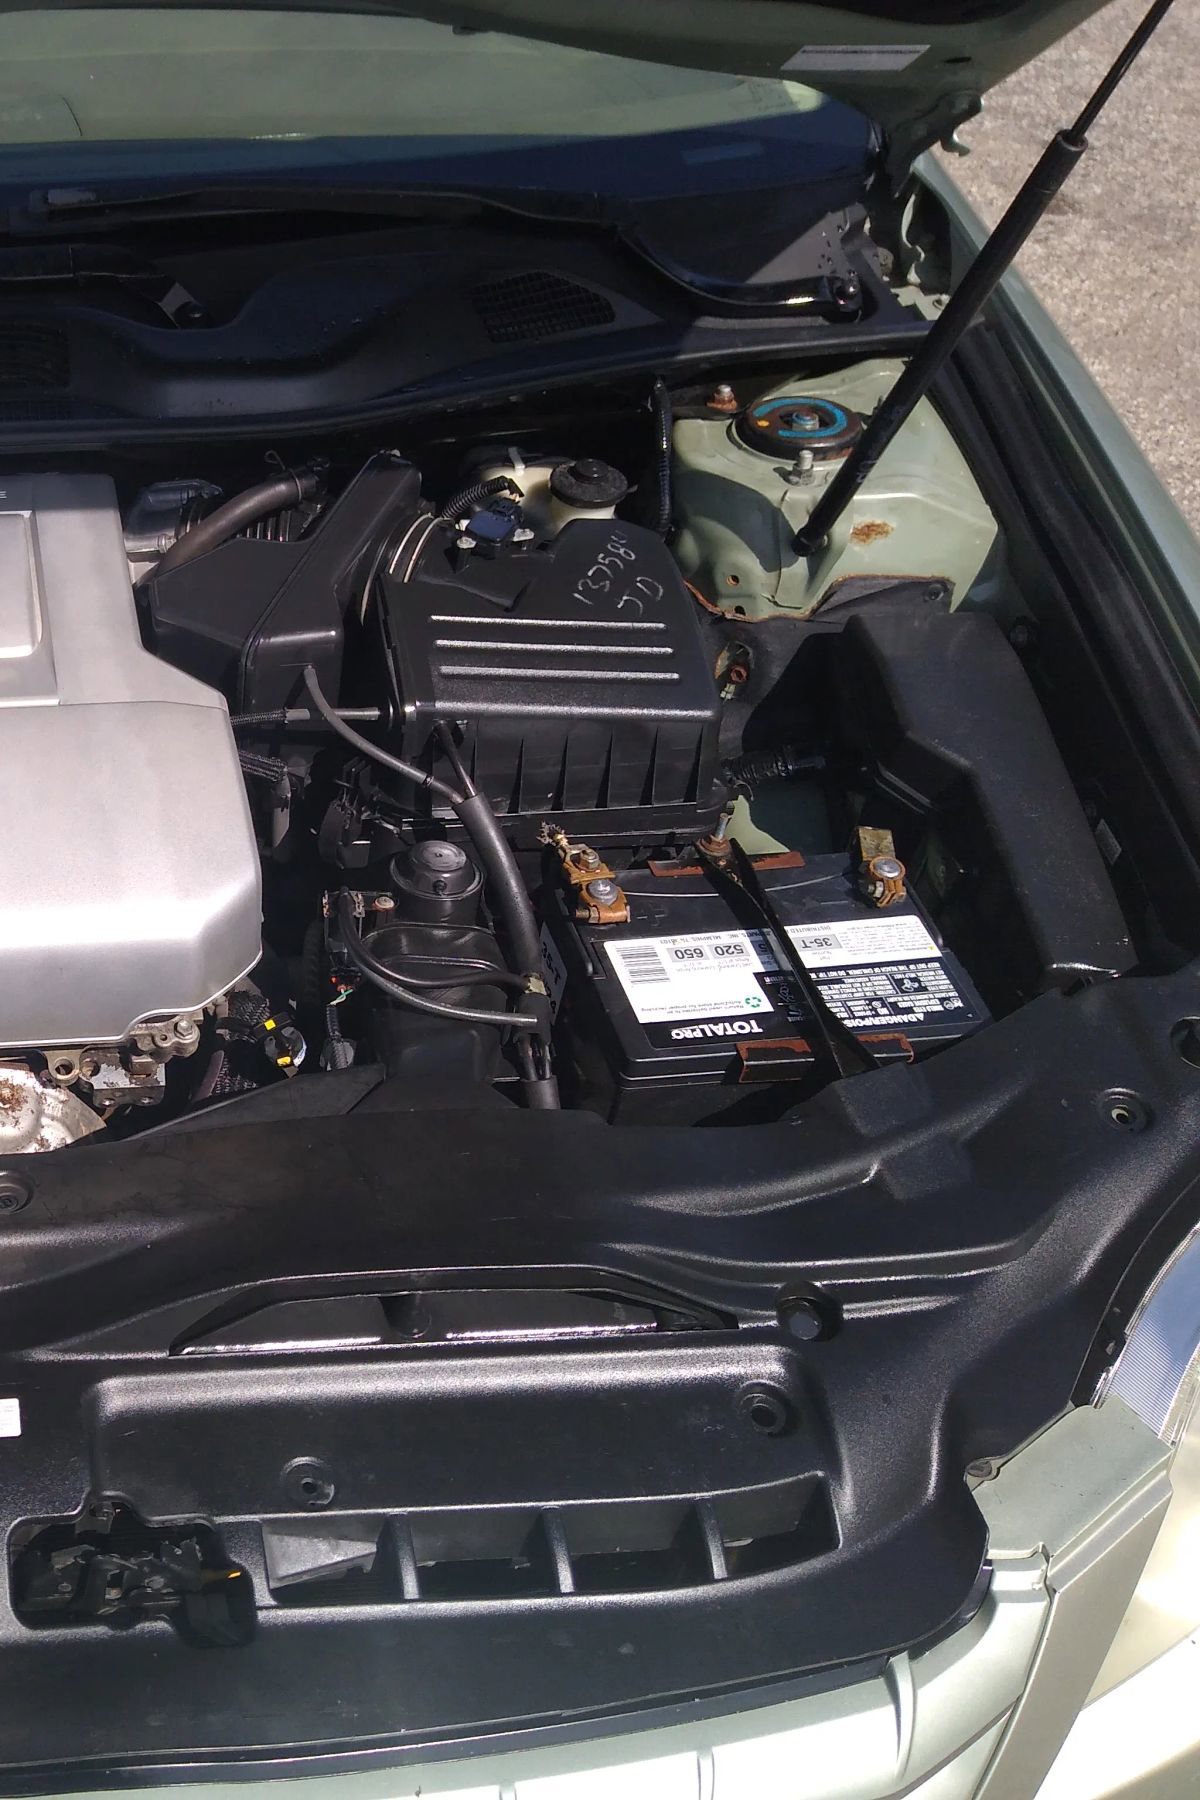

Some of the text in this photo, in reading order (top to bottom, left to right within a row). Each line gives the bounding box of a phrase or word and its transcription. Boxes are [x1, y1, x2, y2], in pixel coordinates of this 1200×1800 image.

[674, 942, 745, 960] 520 650
[800, 937, 833, 949] 35-T
[843, 1013, 918, 1028] DANGER/POIS
[670, 1019, 763, 1040] TOTALPRO
